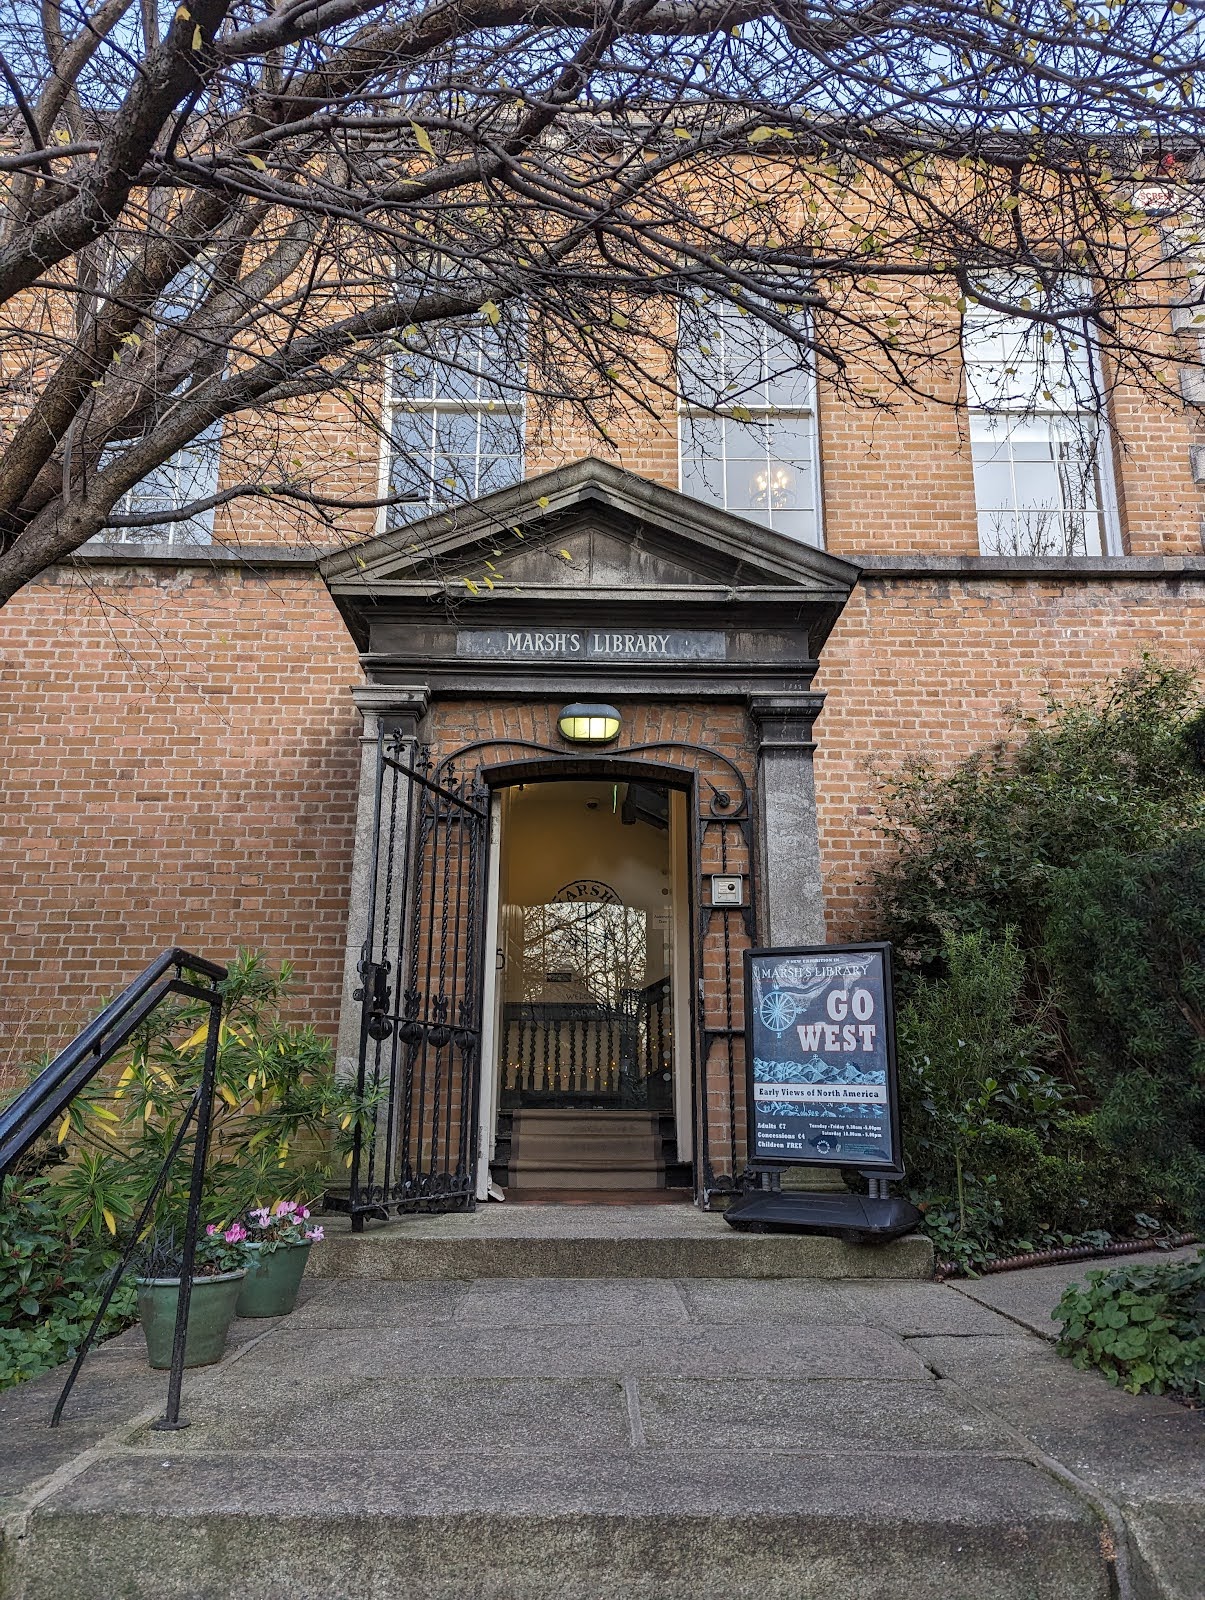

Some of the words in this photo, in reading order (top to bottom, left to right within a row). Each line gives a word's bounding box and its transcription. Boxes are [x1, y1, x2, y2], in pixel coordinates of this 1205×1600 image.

[507, 632, 580, 651] MARSH'S
[593, 634, 670, 653] LIBRARY
[762, 967, 812, 979] MARSH'S
[815, 965, 869, 977] LIBRARY
[826, 988, 874, 1022] GO
[796, 1025, 876, 1052] WEST
[759, 1088, 780, 1098] Early
[781, 1088, 804, 1097] Views
[806, 1088, 815, 1097] of
[816, 1089, 841, 1097] North
[842, 1090, 879, 1098] America
[757, 1122, 777, 1130] Adults
[757, 1131, 795, 1140] Concessions
[757, 1141, 785, 1149] Children
